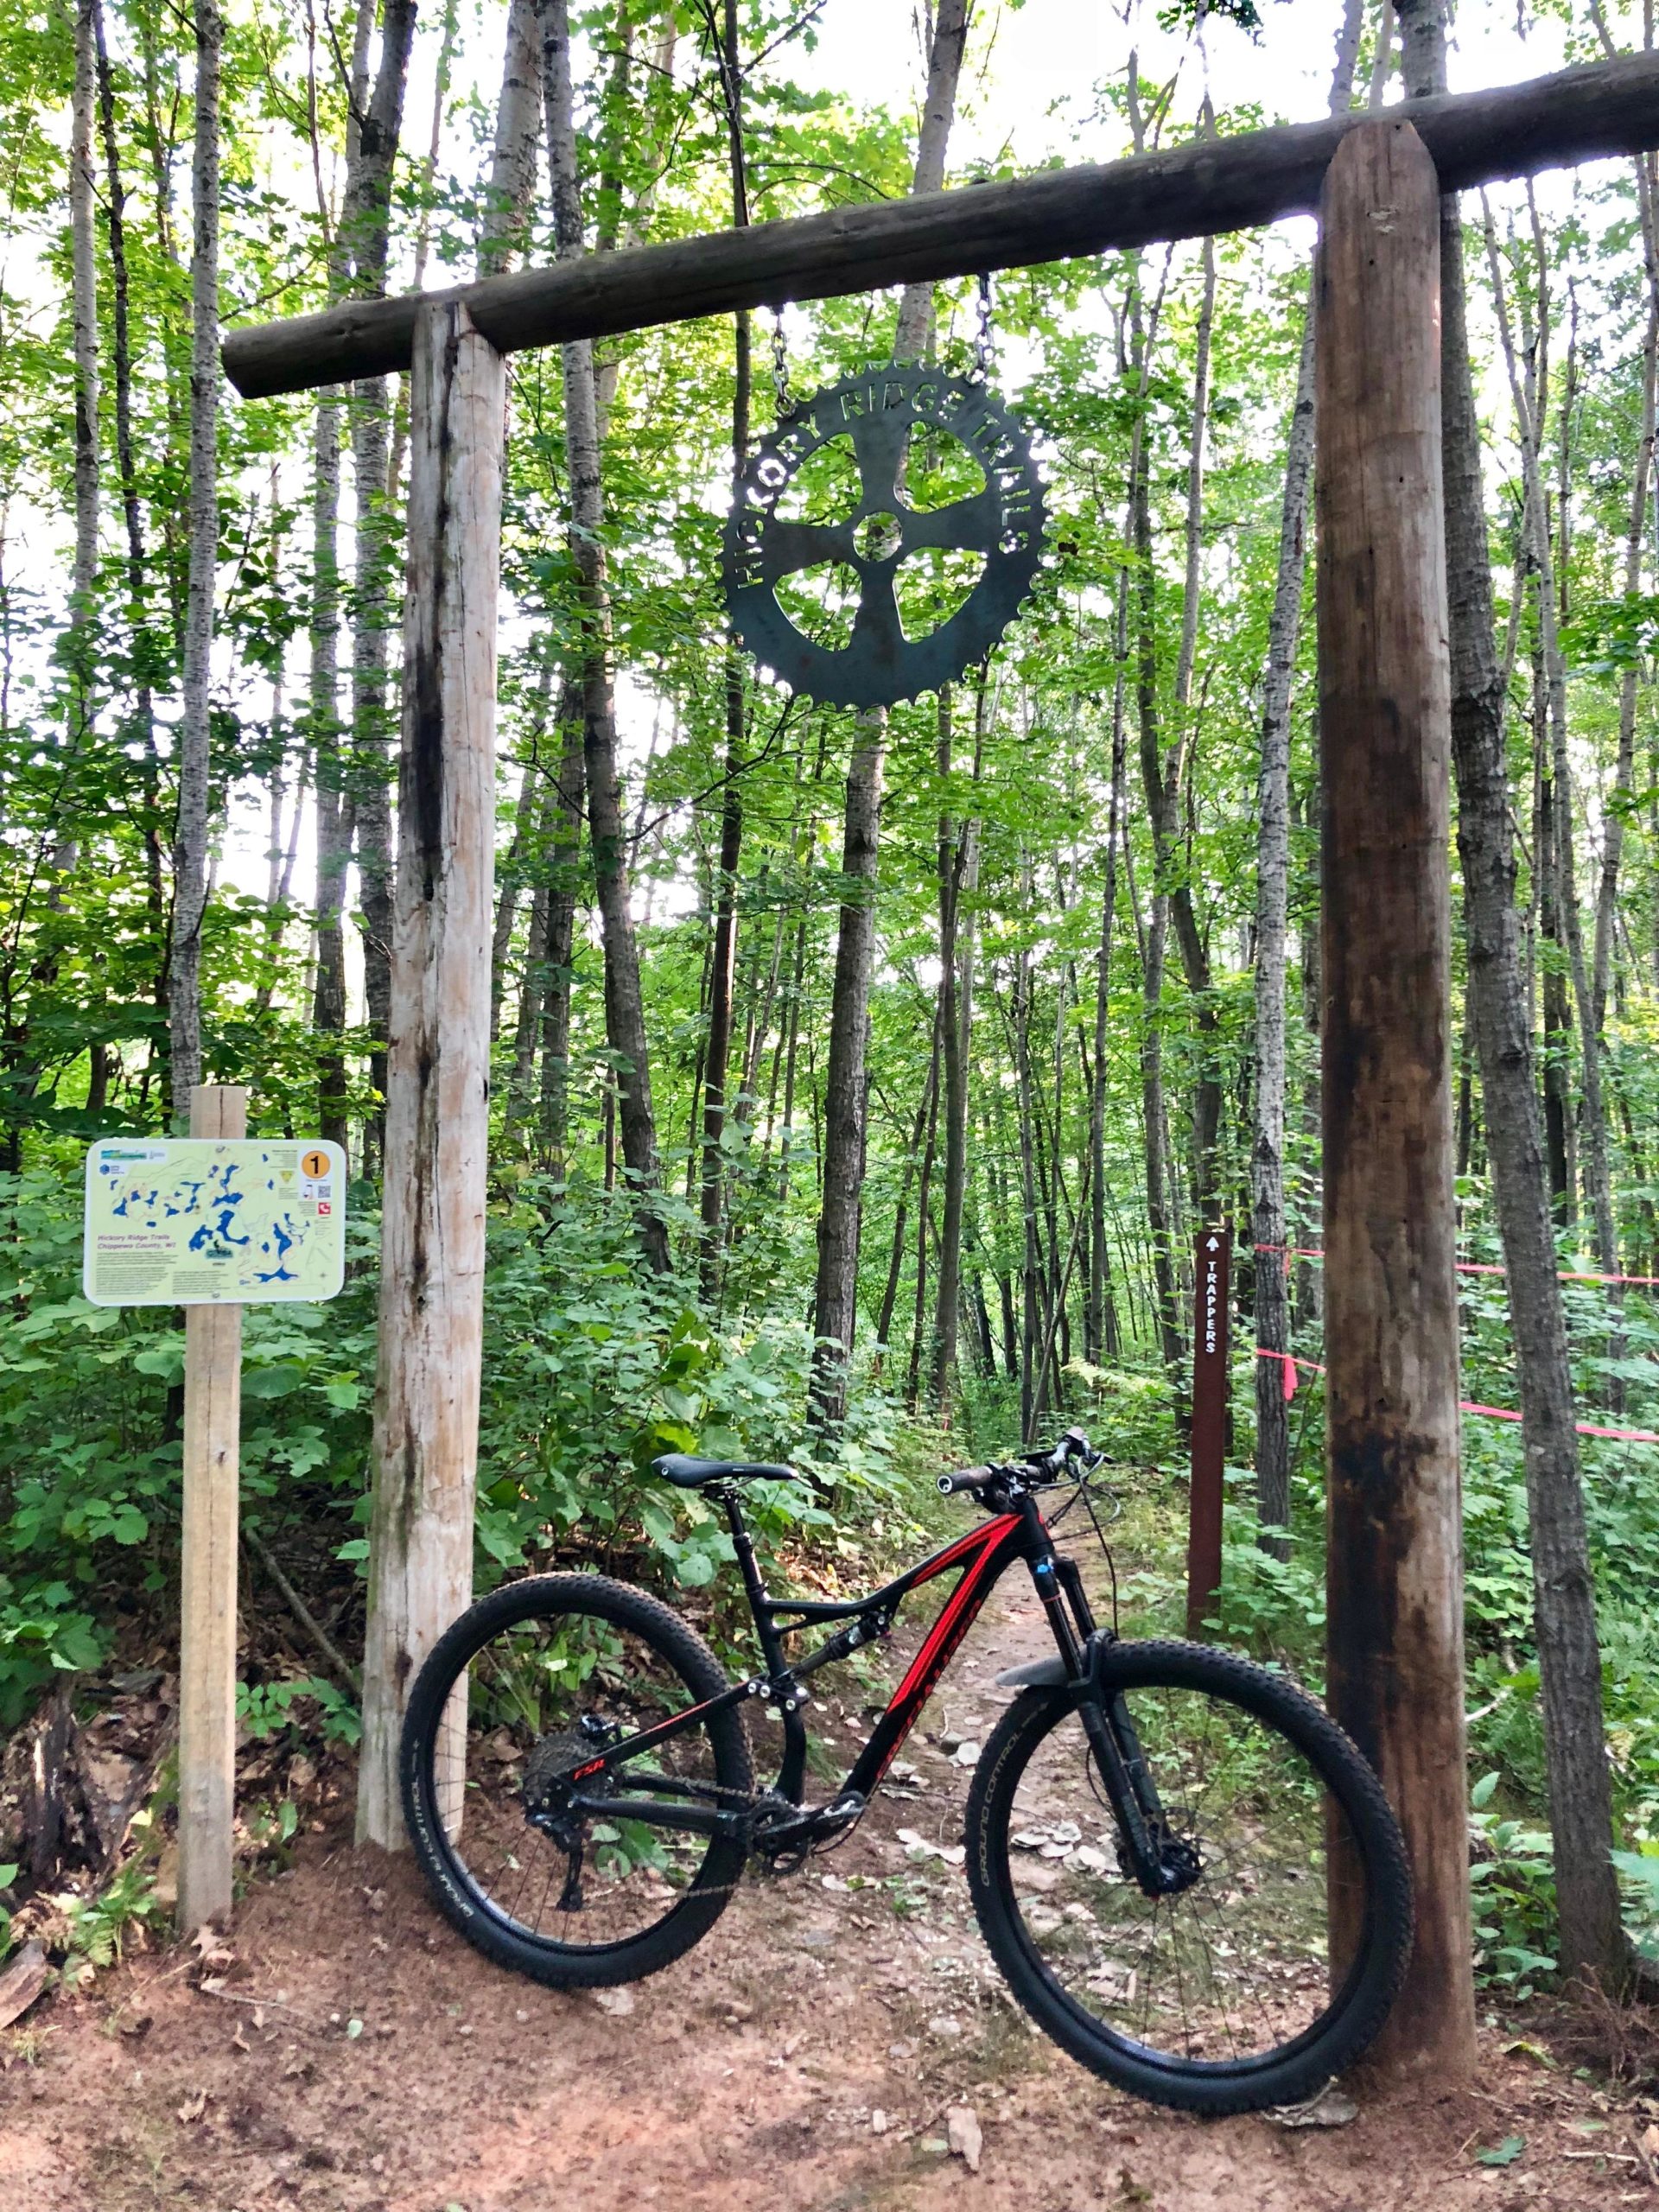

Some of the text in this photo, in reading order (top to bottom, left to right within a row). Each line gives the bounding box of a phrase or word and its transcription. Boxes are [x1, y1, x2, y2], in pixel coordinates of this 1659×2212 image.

[734, 382, 1032, 589] HICKORY RIDGE TRAILS
[309, 1155, 319, 1174] 1
[1206, 1261, 1217, 1353] TRAPPERS
[978, 1732, 1023, 1888] GROUND CONTROL
